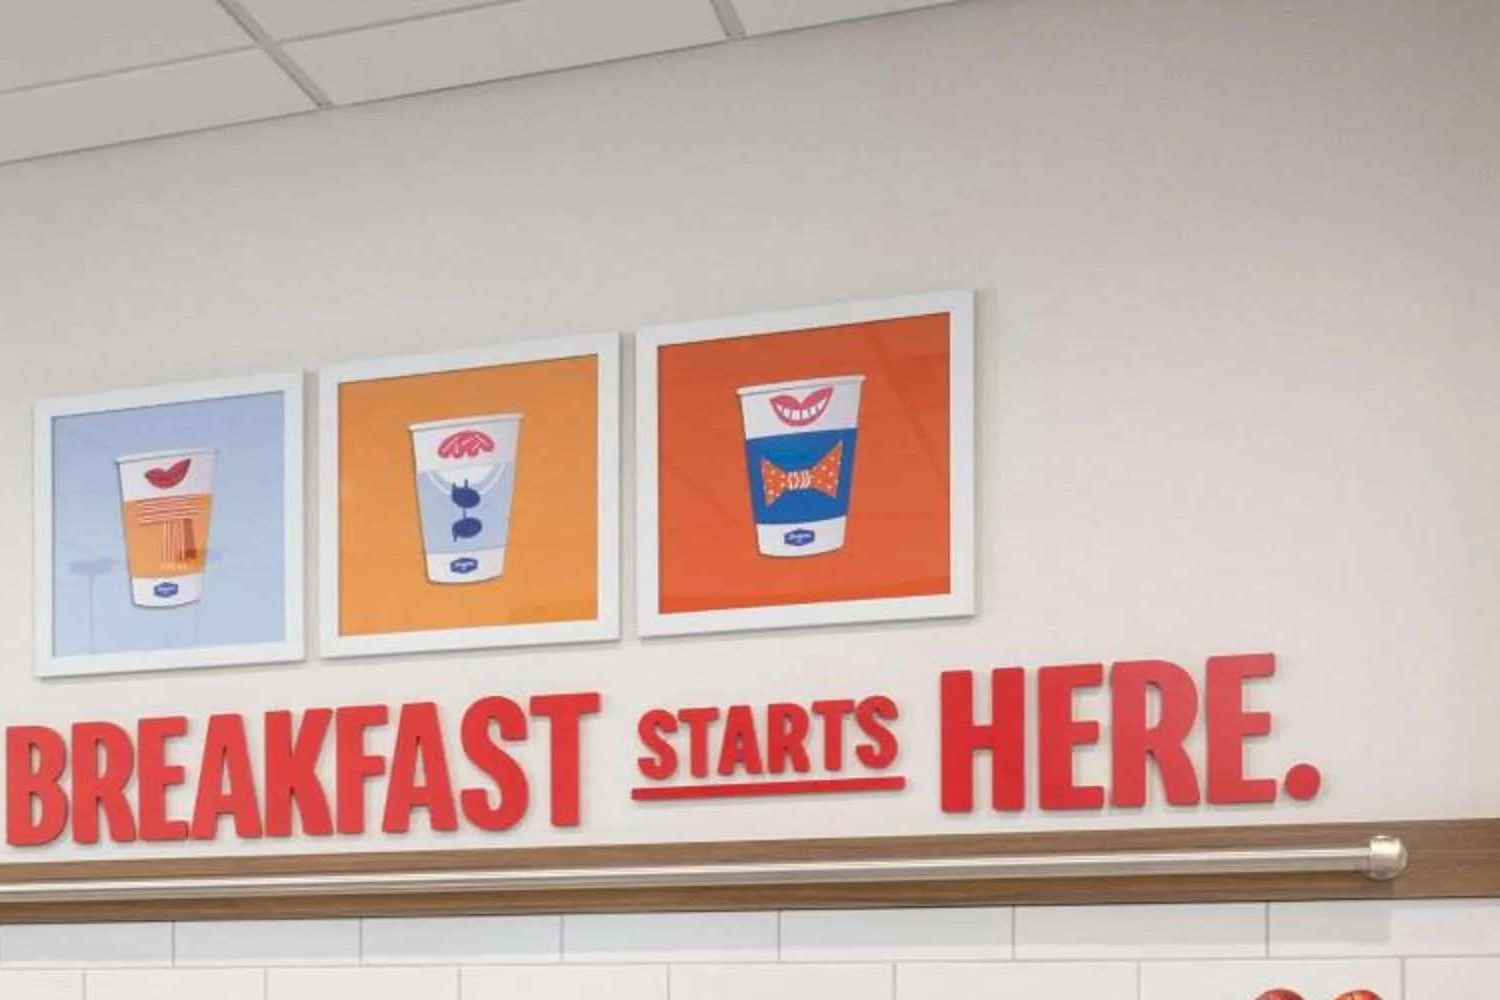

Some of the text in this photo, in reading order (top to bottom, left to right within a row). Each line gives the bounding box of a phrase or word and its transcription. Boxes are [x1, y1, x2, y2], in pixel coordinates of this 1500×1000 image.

[5, 692, 602, 847] BREAKFAST
[636, 694, 900, 780] STARTS
[939, 653, 1322, 813] HERE.
